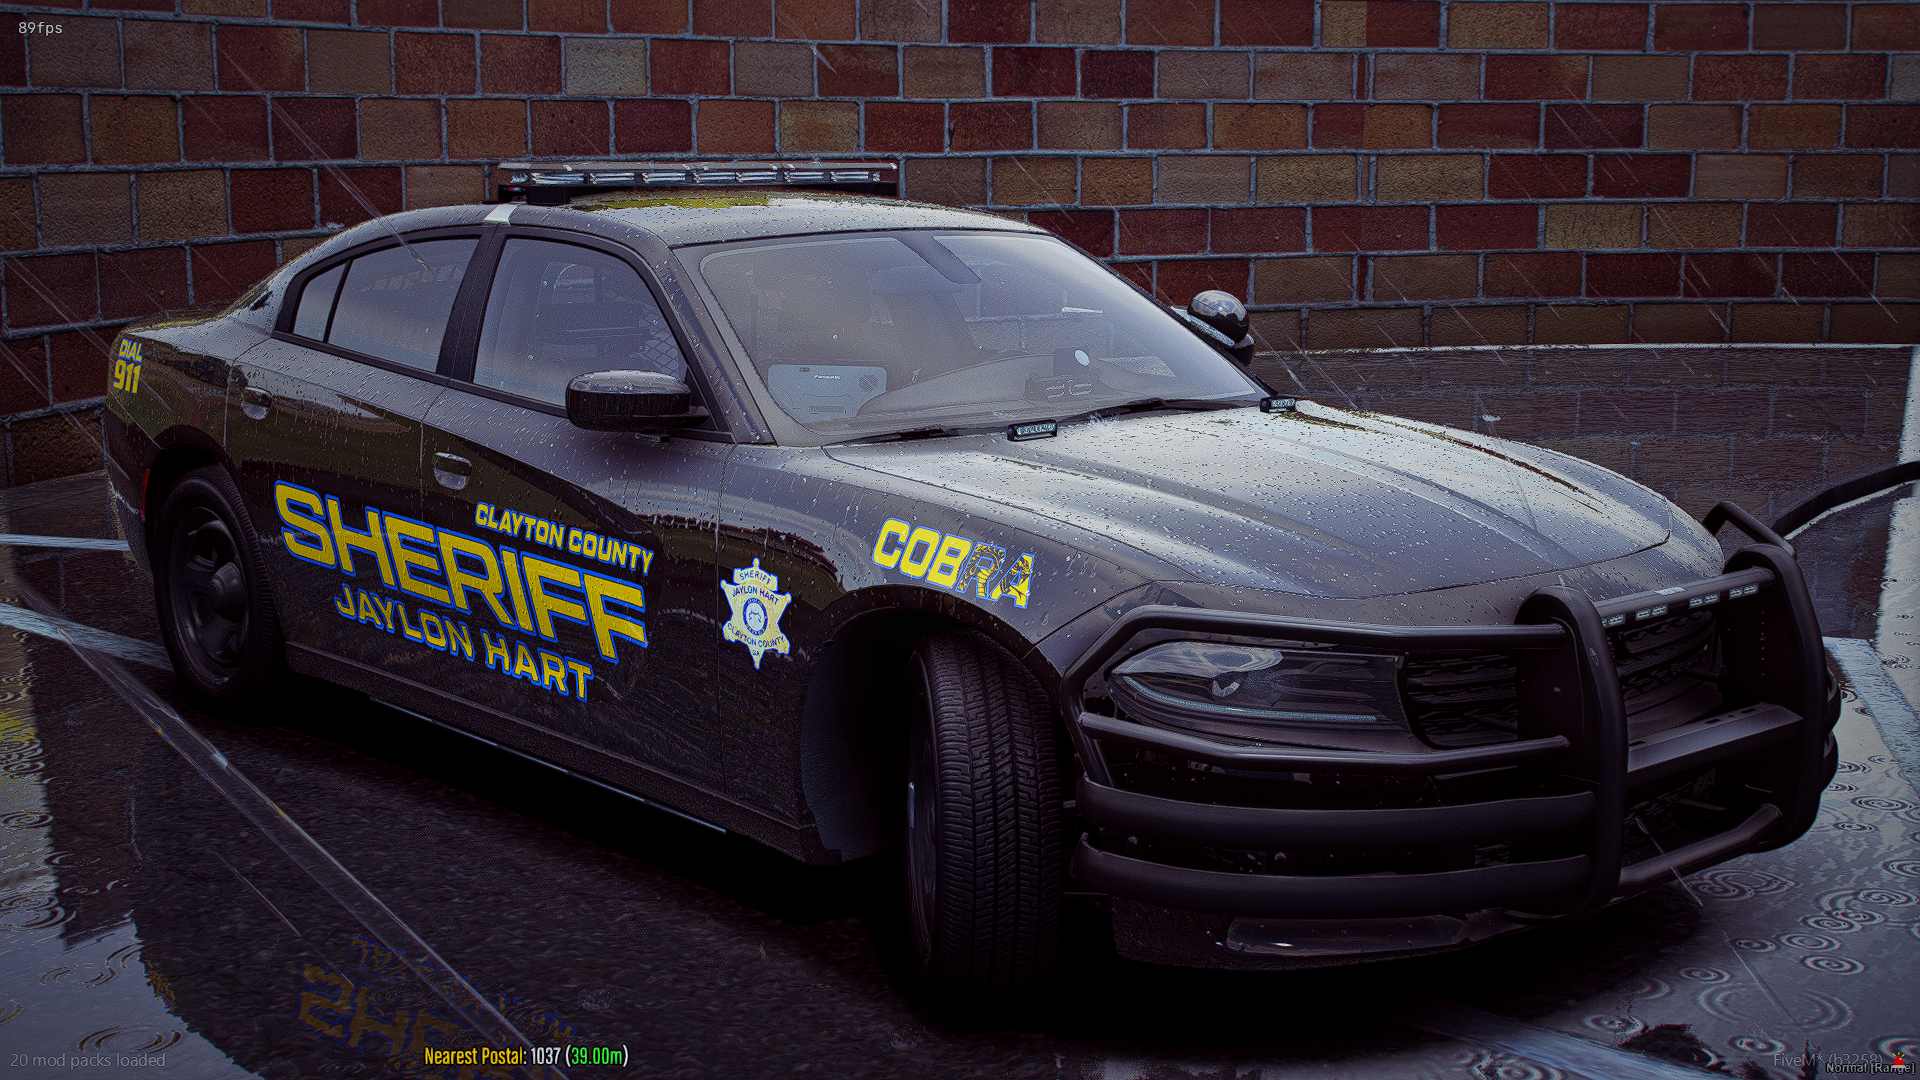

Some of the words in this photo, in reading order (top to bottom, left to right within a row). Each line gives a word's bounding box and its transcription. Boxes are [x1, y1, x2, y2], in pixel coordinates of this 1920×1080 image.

[119, 338, 143, 363] DIAL
[113, 359, 141, 395] 911
[475, 502, 564, 550] CLAYTON
[567, 528, 654, 576] COUNTY
[274, 480, 648, 664] SHERIFF
[739, 570, 772, 585] SHERIFF
[872, 517, 1035, 609] COBRA
[732, 586, 758, 597] JAYLON
[759, 588, 779, 606] HART
[335, 583, 475, 662] JAYLON
[480, 628, 594, 702] HART
[727, 622, 757, 647] CLAYTON
[758, 635, 785, 648] COUNTY
